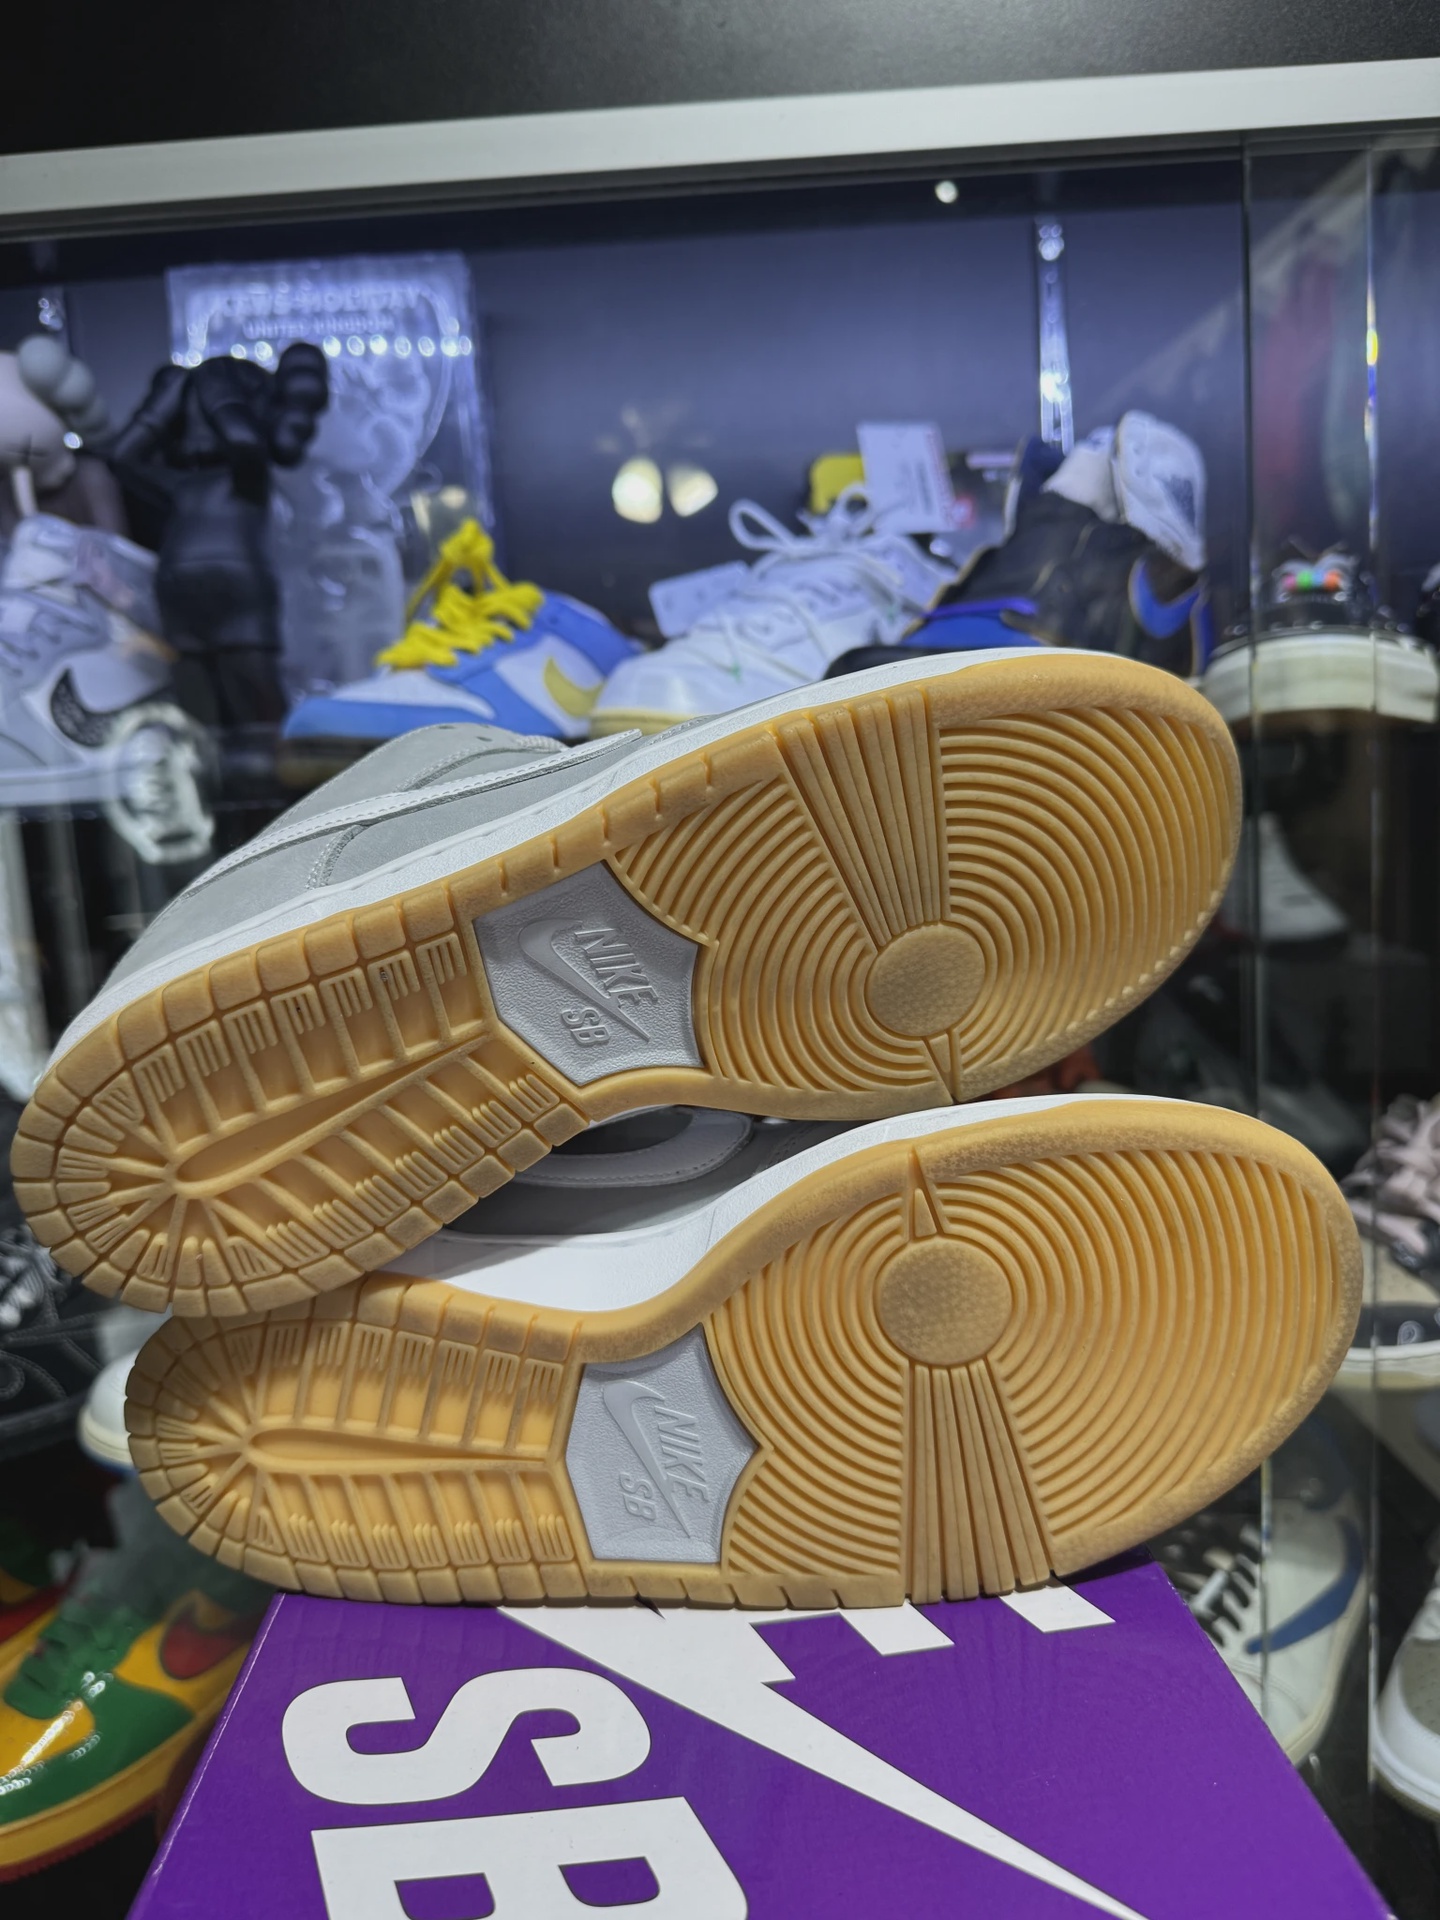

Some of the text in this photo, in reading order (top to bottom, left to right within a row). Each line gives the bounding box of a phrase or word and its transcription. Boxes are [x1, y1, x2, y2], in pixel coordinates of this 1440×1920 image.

[573, 927, 659, 1007] NIKE
[560, 1006, 611, 1046] SB
[654, 1405, 709, 1502] NIKE
[619, 1471, 657, 1522] SB
[282, 1667, 749, 1920] SB
